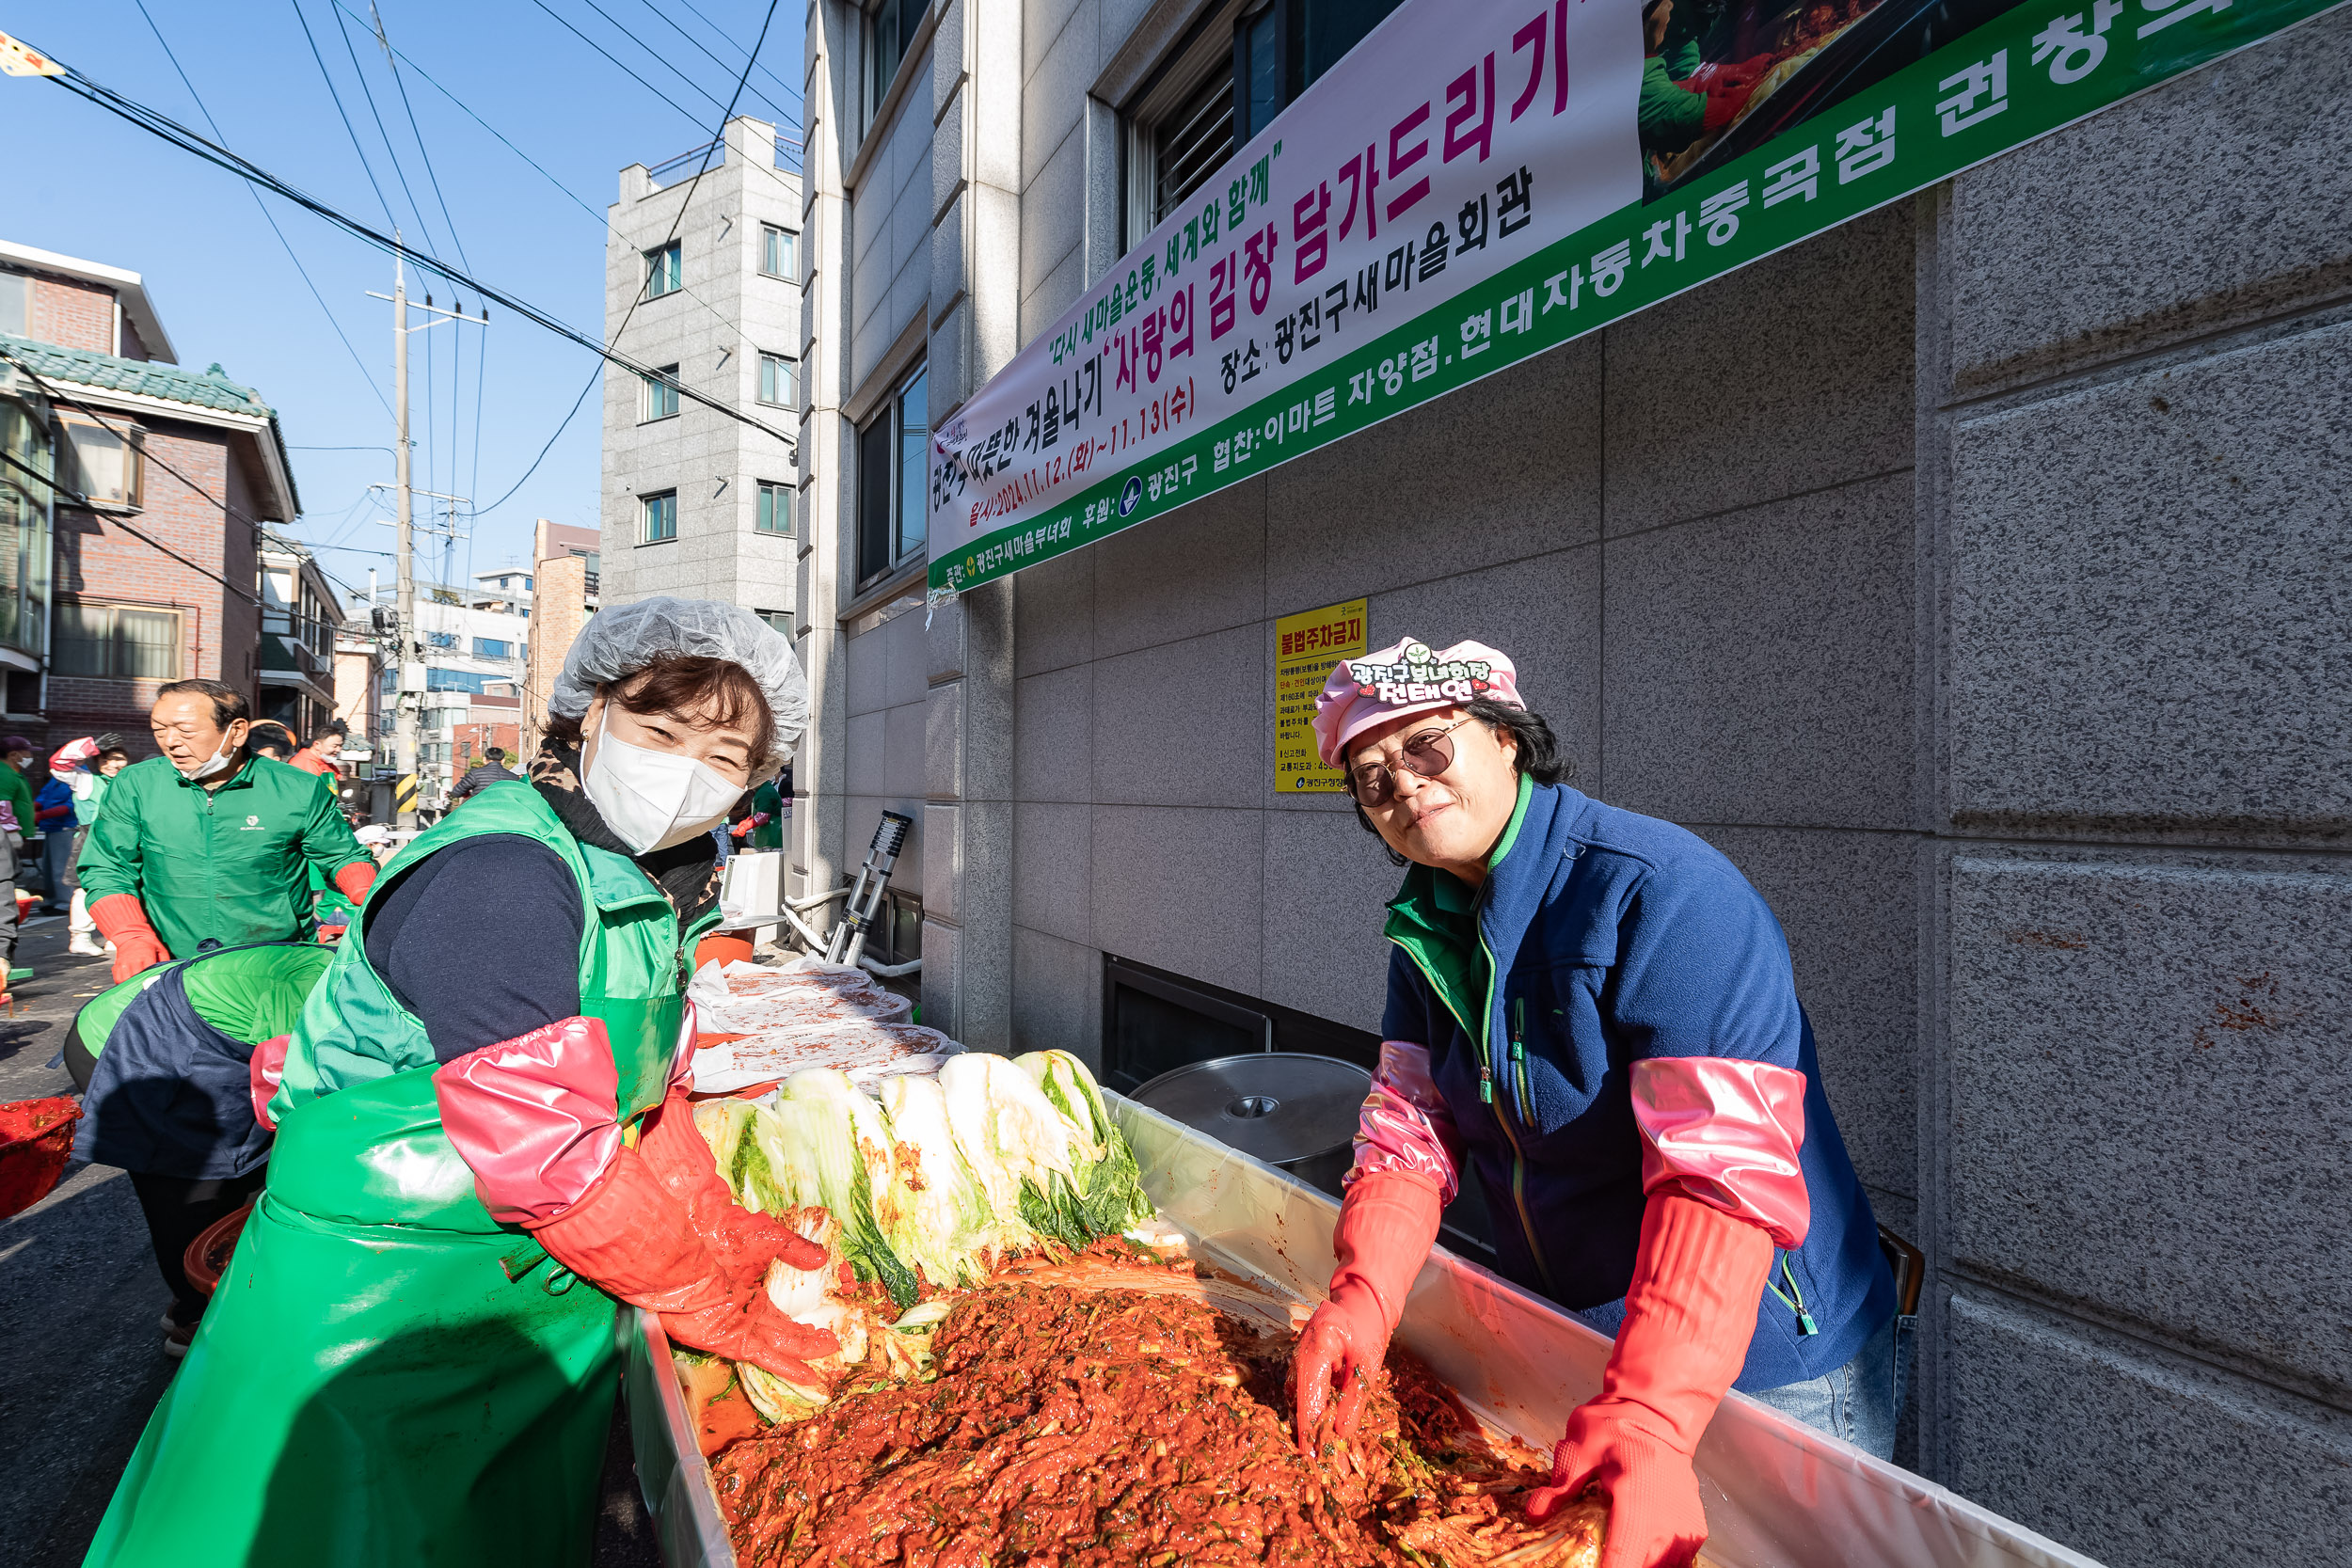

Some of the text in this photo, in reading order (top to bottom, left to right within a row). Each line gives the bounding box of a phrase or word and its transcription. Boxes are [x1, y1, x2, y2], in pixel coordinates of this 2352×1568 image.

[966, 416, 1021, 486] 따뜻한
[1208, 219, 1279, 342] 김장
[1293, 0, 1586, 286] 담가드리기
[976, 515, 1073, 575] 광진구새마을부녀회
[1082, 497, 1116, 530] 후원:
[1147, 454, 1199, 501] 광진구
[1281, 618, 1360, 656] 불법주차금지
[1375, 679, 1474, 705] 전태연
[1279, 717, 1309, 728] 불법주차를
[1283, 749, 1307, 758] 신고전화
